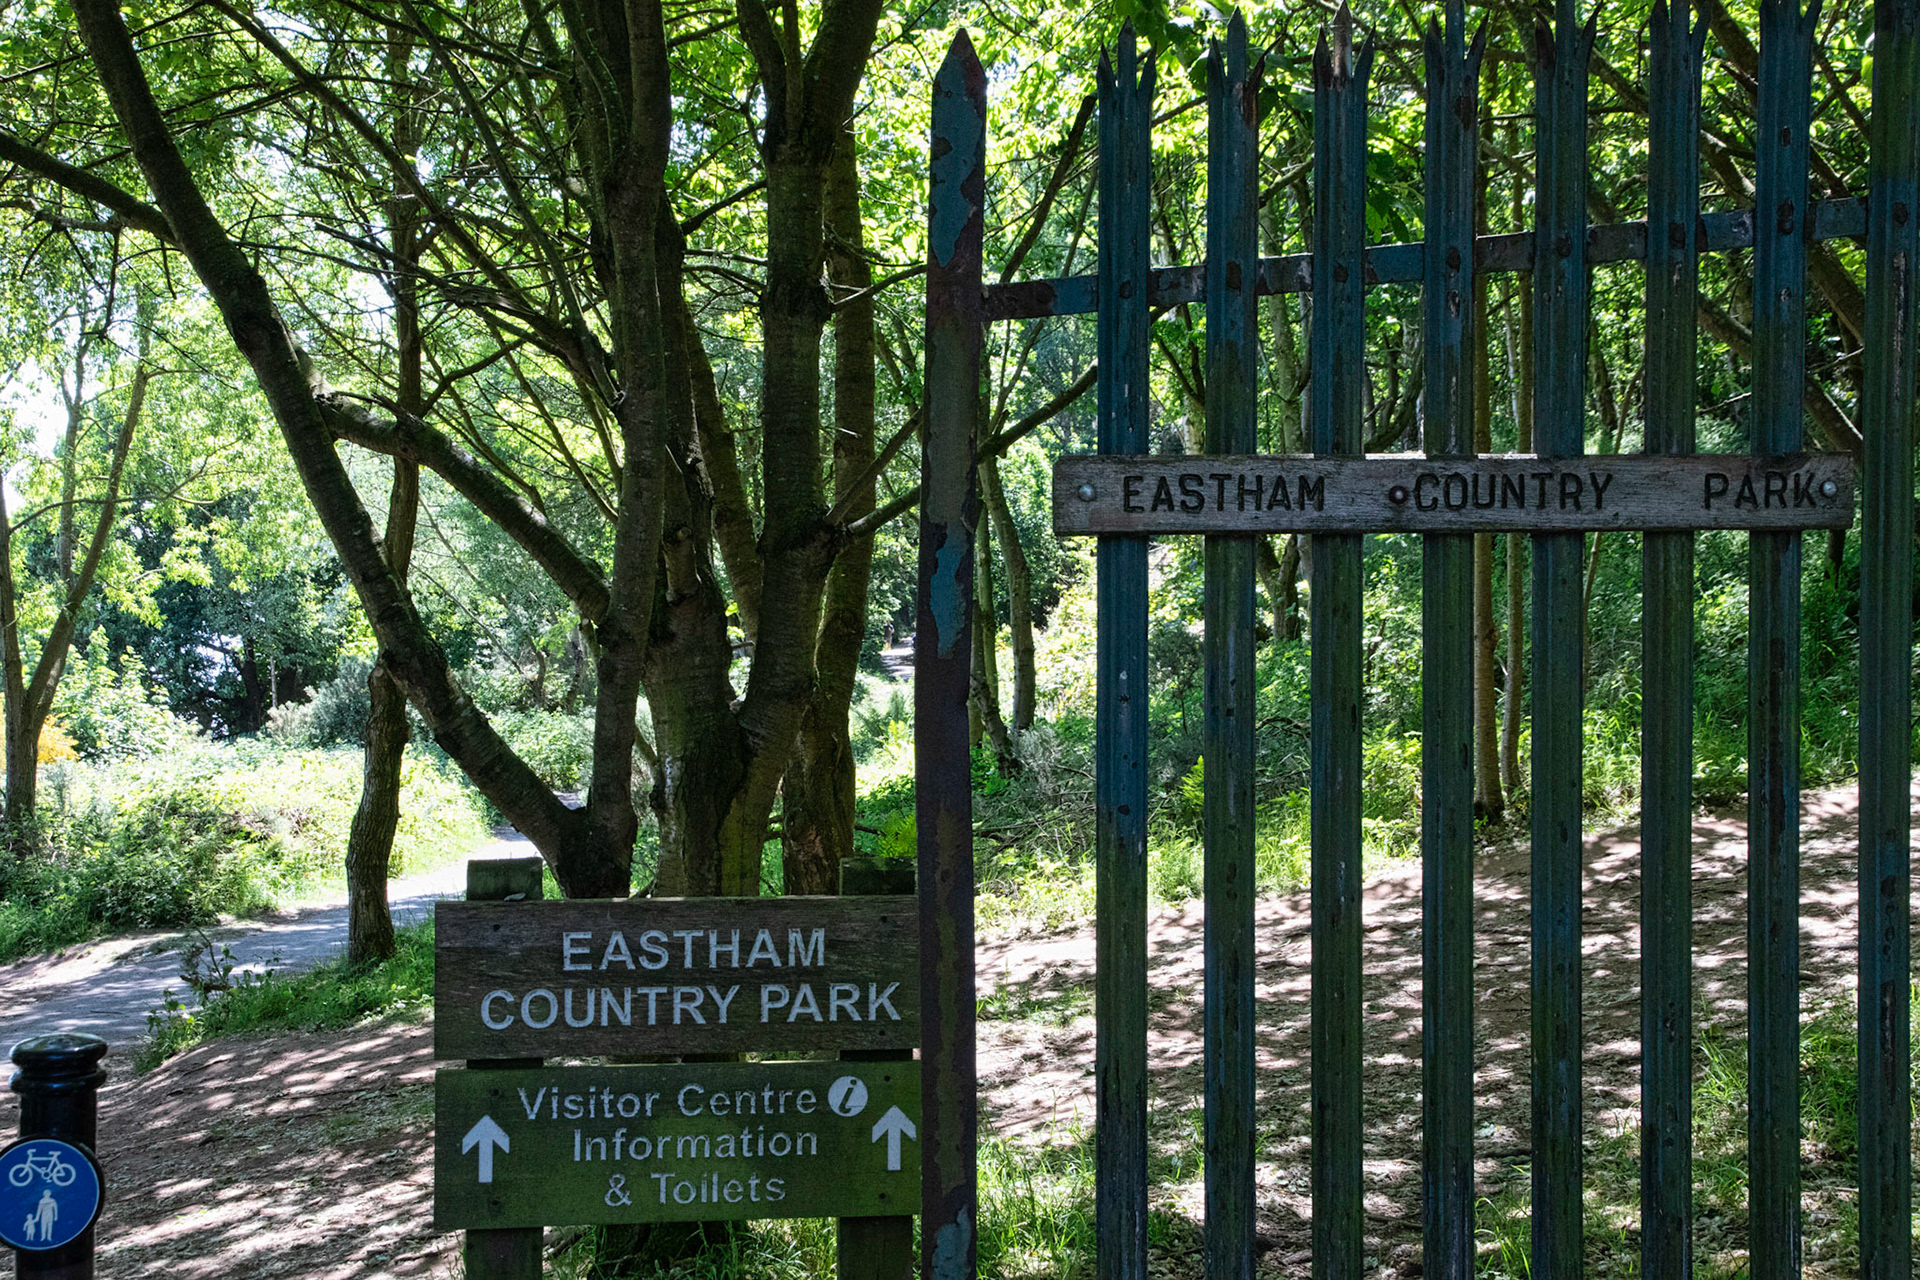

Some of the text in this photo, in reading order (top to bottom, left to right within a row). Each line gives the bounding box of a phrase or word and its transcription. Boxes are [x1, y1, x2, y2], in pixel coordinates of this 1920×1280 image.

[1122, 471, 1818, 513] EASTHAM COUNTRY PARK
[562, 928, 826, 971] EASTHAM
[480, 981, 902, 1030] COUNTRY PARK
[518, 1085, 660, 1120] Visitor
[677, 1083, 817, 1117] Centre
[573, 1126, 818, 1162] Information
[604, 1171, 787, 1207] & Toilets
